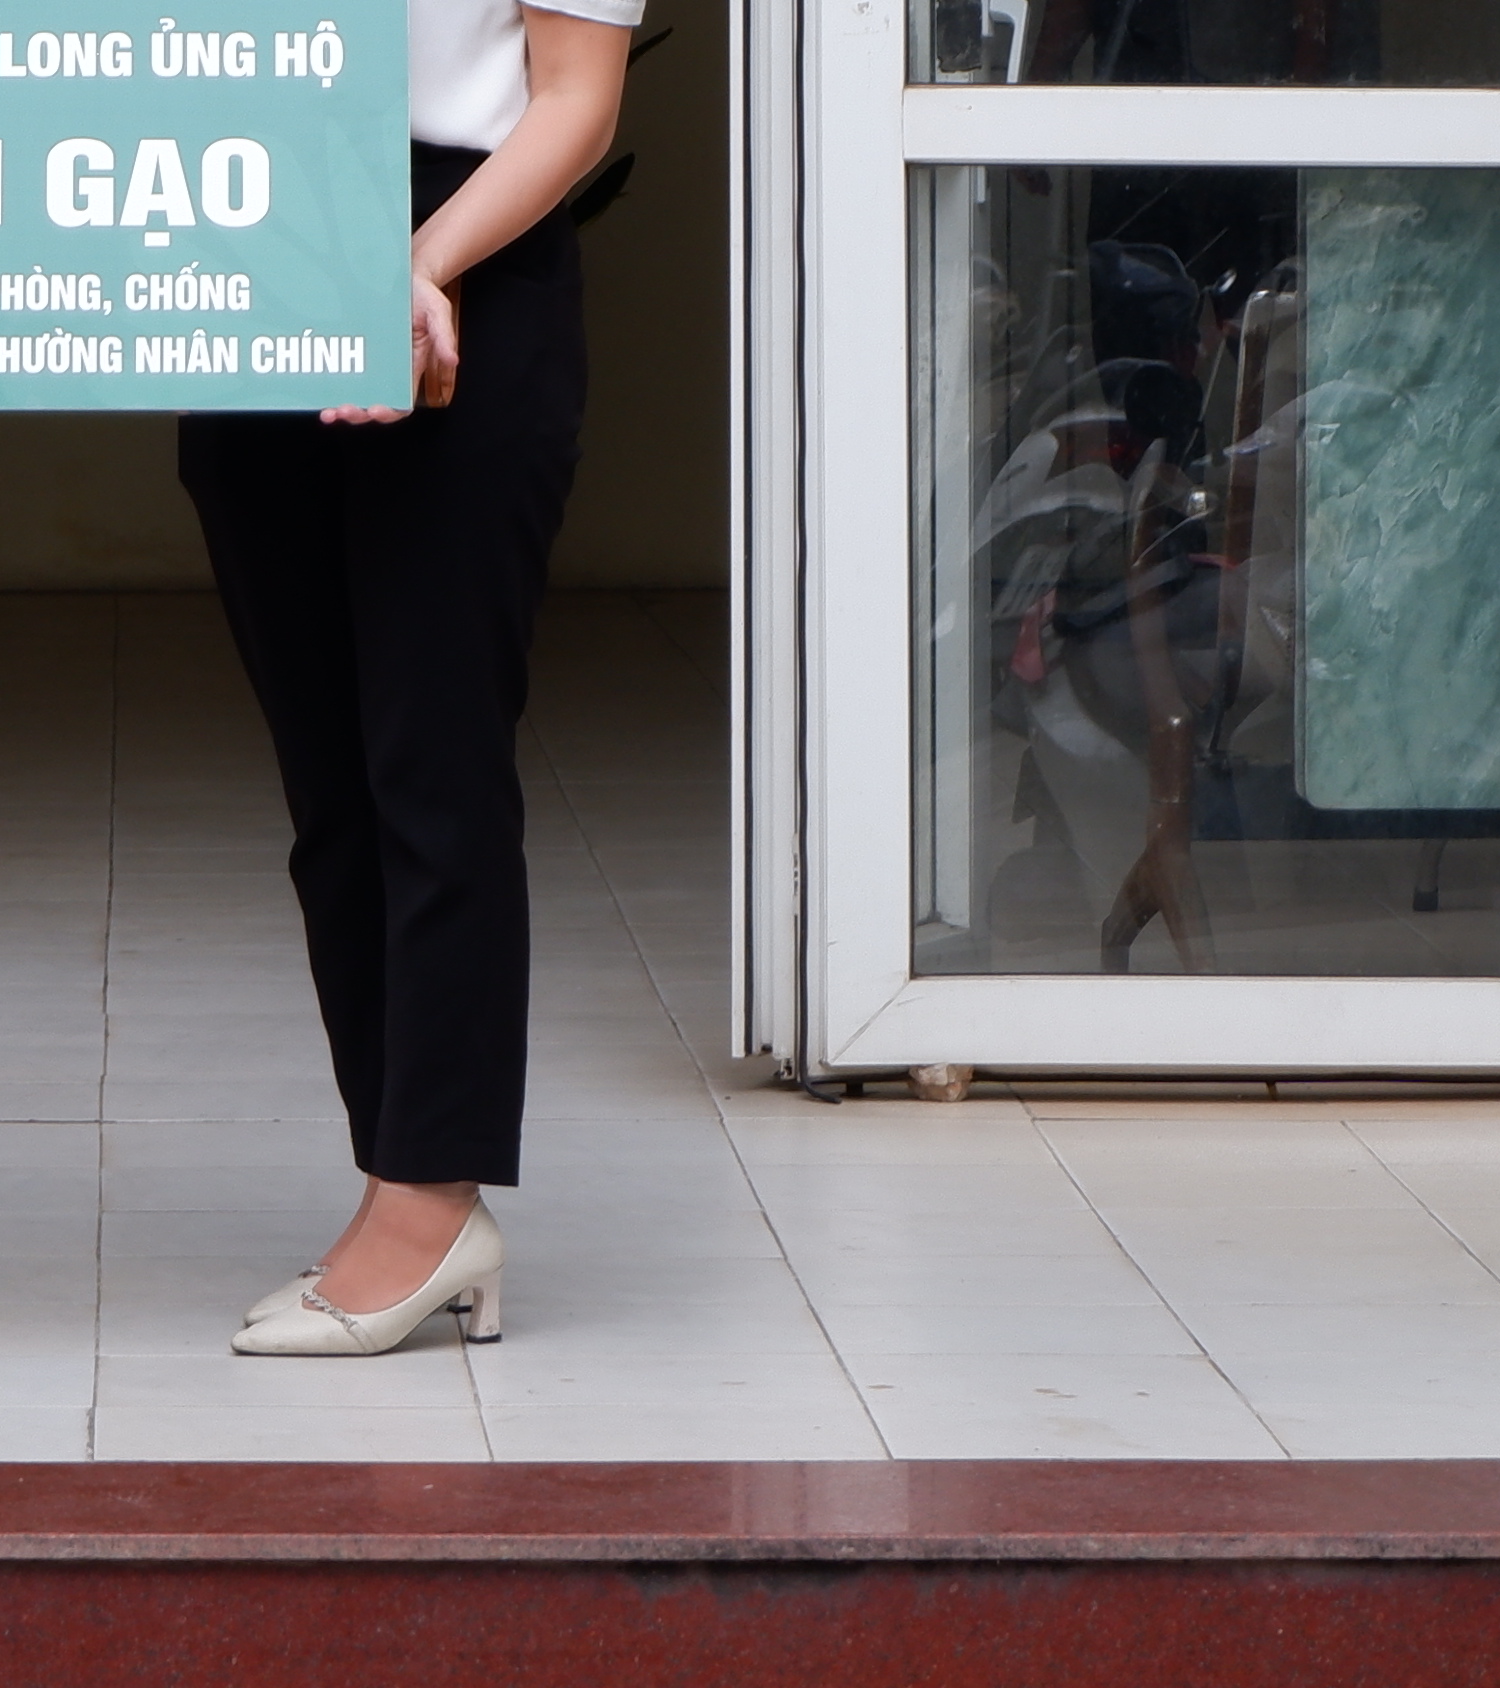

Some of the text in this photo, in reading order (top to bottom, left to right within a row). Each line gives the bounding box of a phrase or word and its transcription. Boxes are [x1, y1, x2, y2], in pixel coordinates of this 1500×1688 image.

[0, 32, 133, 79] LONG
[150, 17, 256, 78] ỦNG
[273, 21, 344, 89] HỘ
[45, 137, 271, 247] GẠO
[124, 260, 251, 312] CHỐNG
[134, 330, 240, 375] NHÂN
[251, 328, 364, 375] CHÍNH
